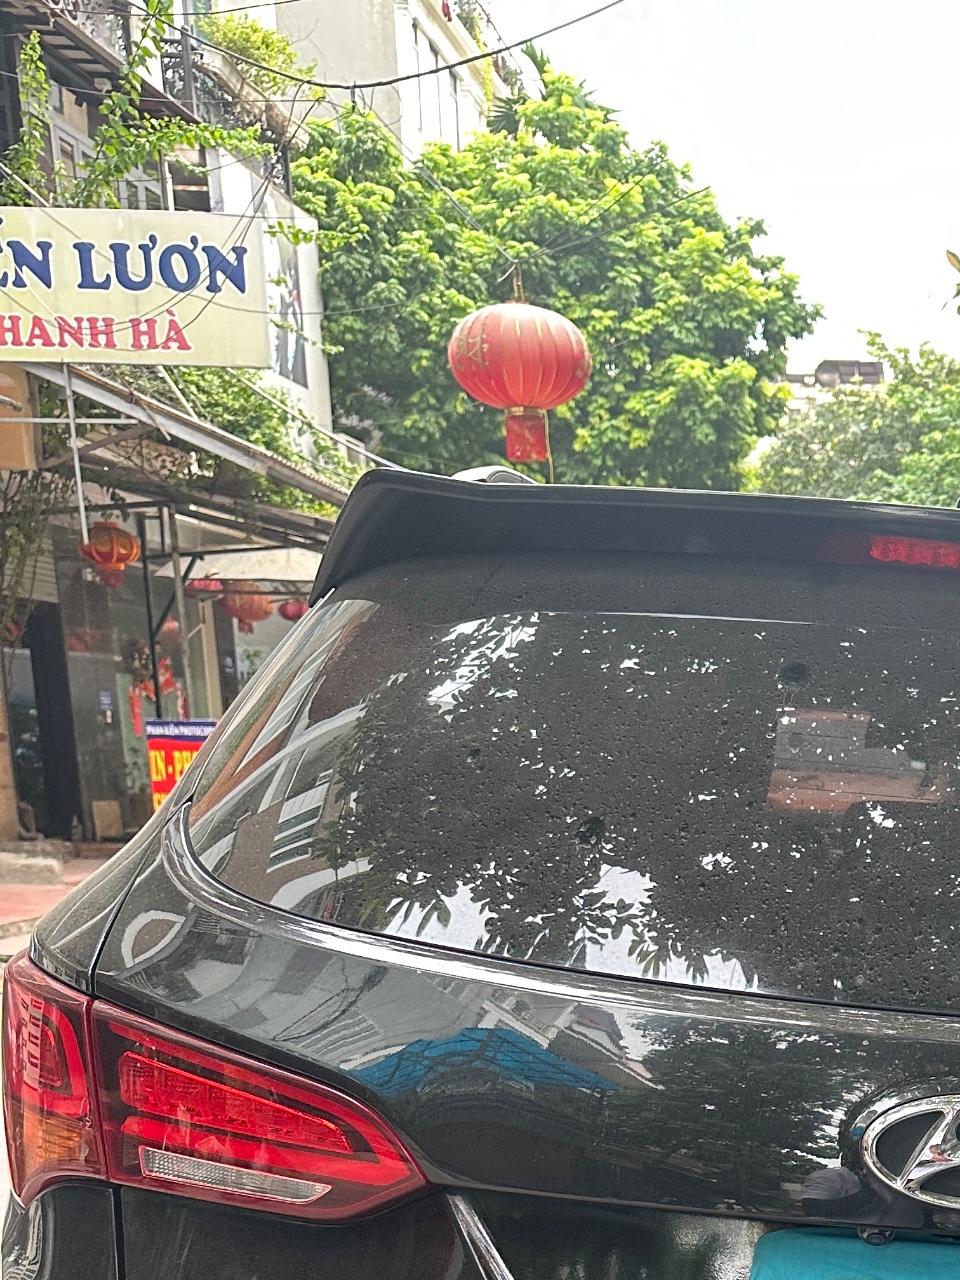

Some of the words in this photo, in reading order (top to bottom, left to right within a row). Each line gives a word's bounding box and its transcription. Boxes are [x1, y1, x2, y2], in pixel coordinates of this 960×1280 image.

[0, 217, 53, 289] N
[73, 234, 247, 294] LƯƠN
[129, 309, 192, 351] HÀ
[173, 750, 199, 782] PH
